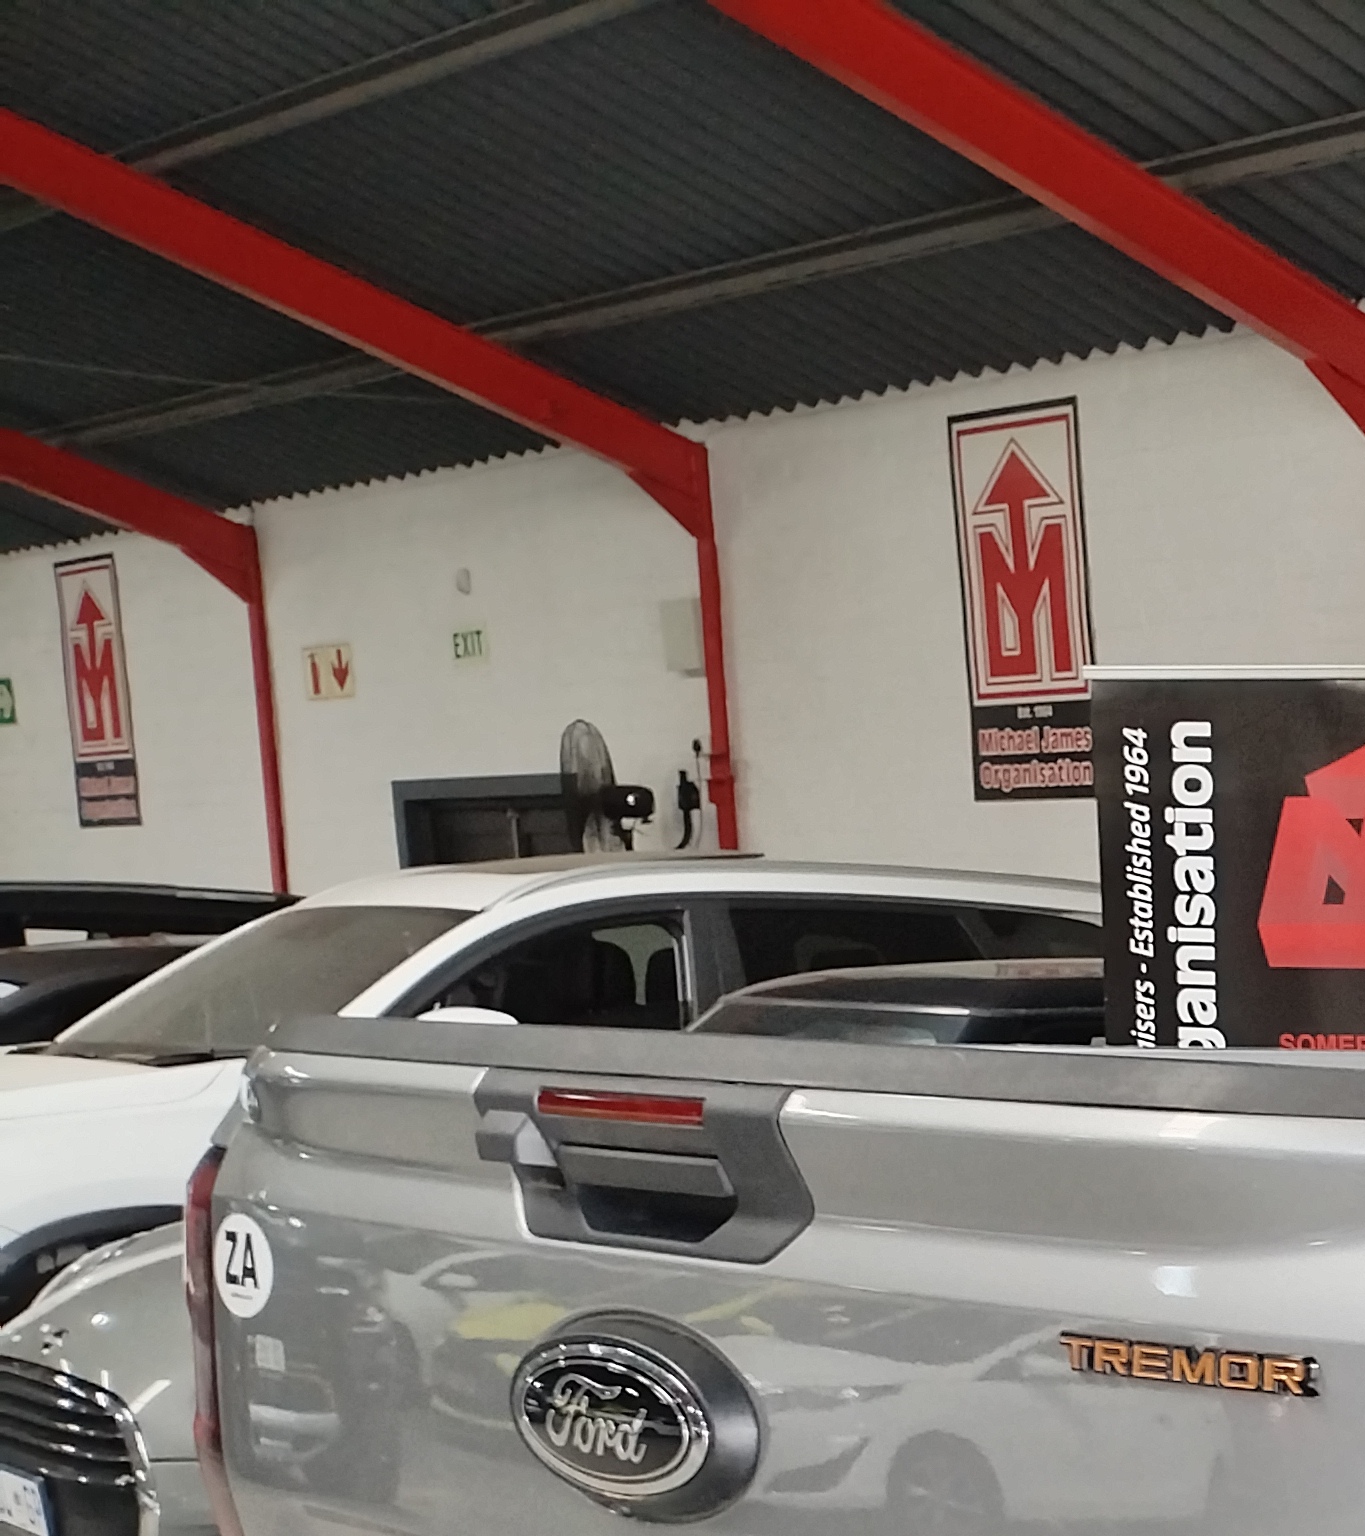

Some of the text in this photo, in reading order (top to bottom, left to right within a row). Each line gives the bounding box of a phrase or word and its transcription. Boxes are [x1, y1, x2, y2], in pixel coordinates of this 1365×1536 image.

[453, 630, 482, 658] EXIT
[978, 725, 1093, 756] Michael James
[1122, 727, 1150, 796] 1964
[979, 758, 1094, 792] Organisation
[1123, 801, 1154, 957] Established
[225, 1230, 260, 1290] ZA
[1059, 1330, 1320, 1396] TREMOR
[545, 1372, 649, 1464] Ford
